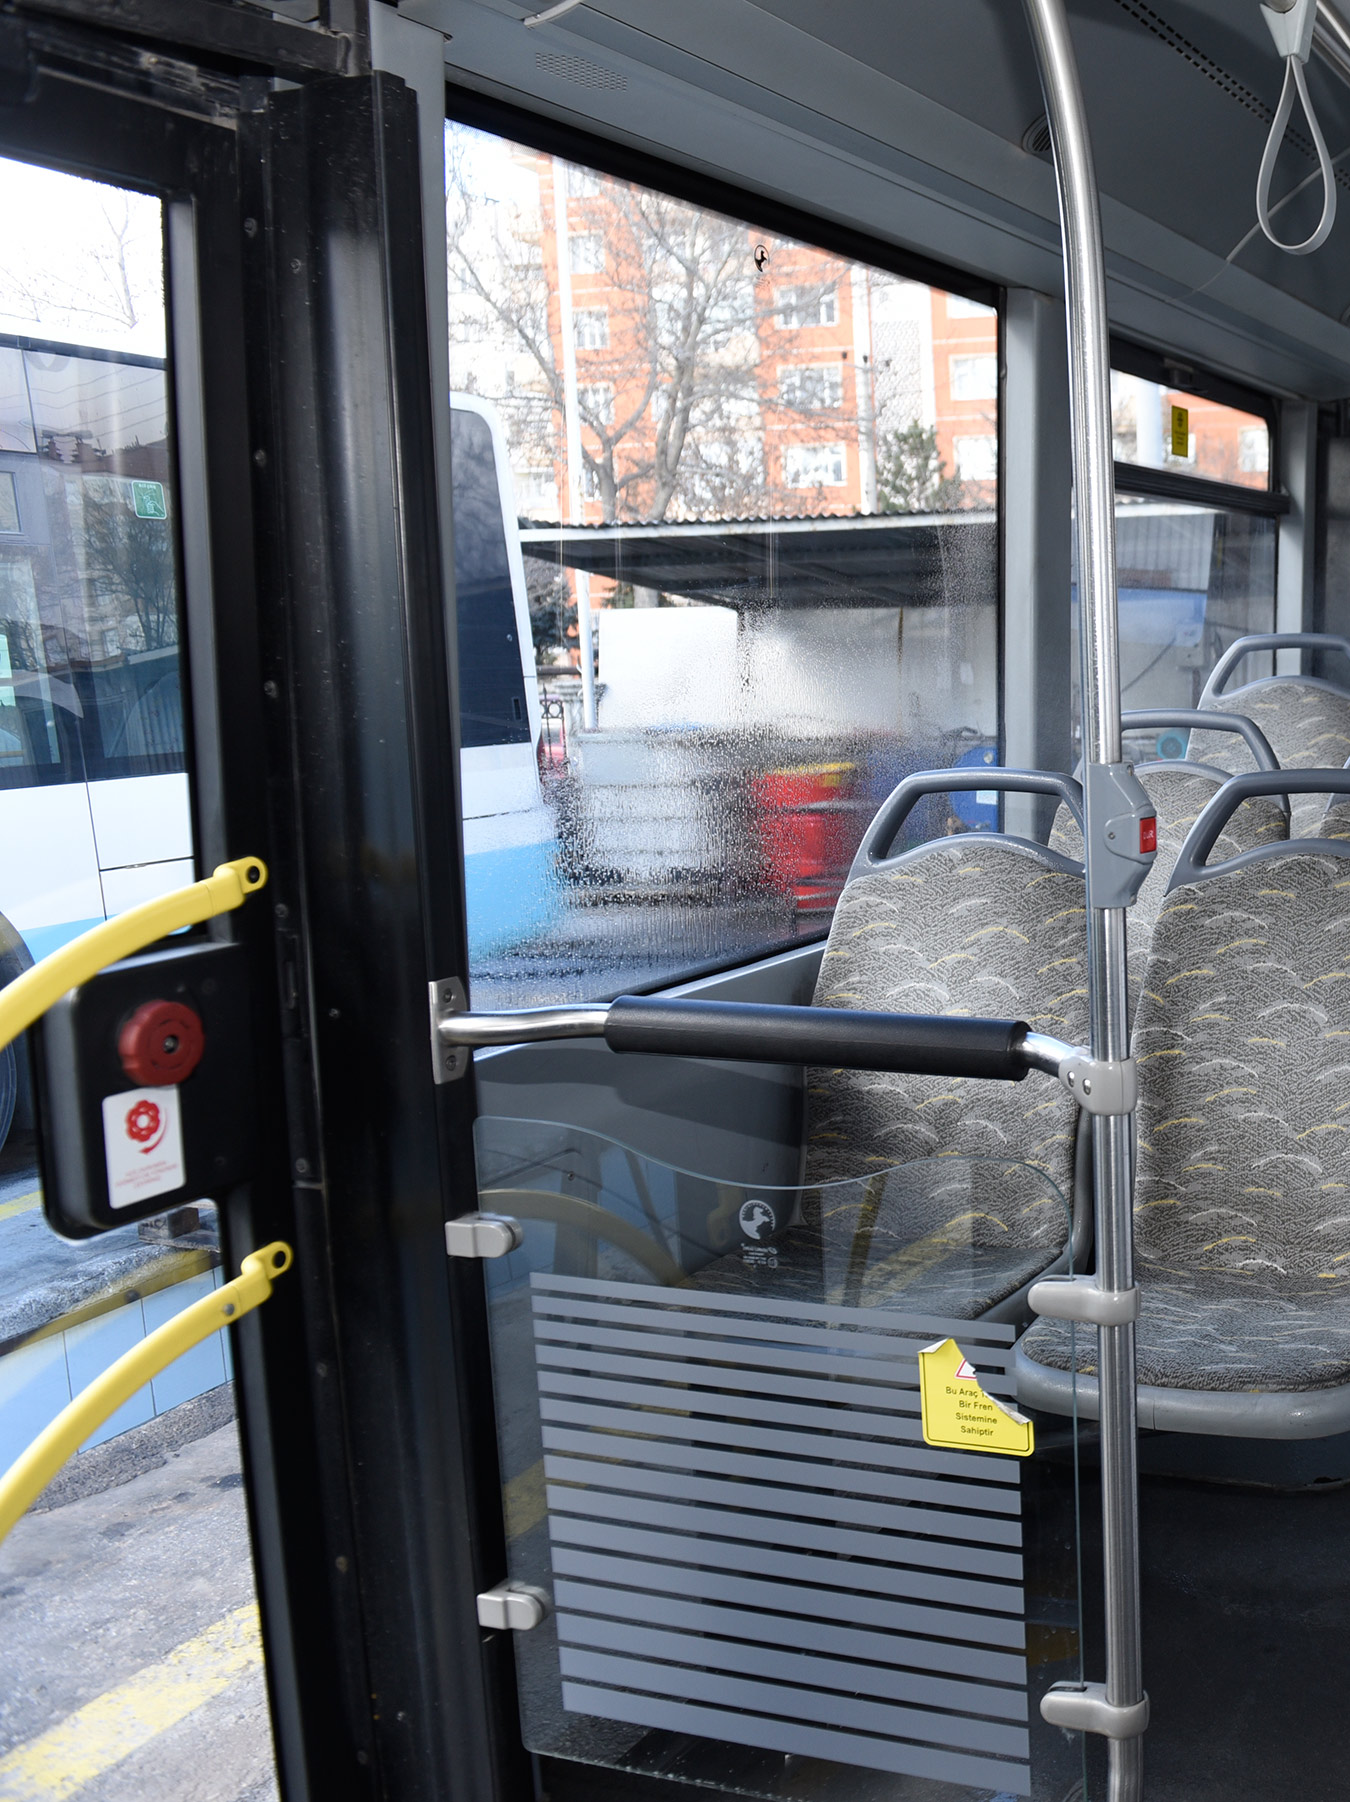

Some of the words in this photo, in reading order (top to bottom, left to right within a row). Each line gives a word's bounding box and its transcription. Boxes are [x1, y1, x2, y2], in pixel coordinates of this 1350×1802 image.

[945, 1386, 957, 1395] Bu
[959, 1388, 978, 1399] Araç
[959, 1400, 971, 1408] Bir
[973, 1402, 993, 1411] Fren
[955, 1412, 998, 1424] Sistemine
[960, 1425, 994, 1437] Sahiptir
